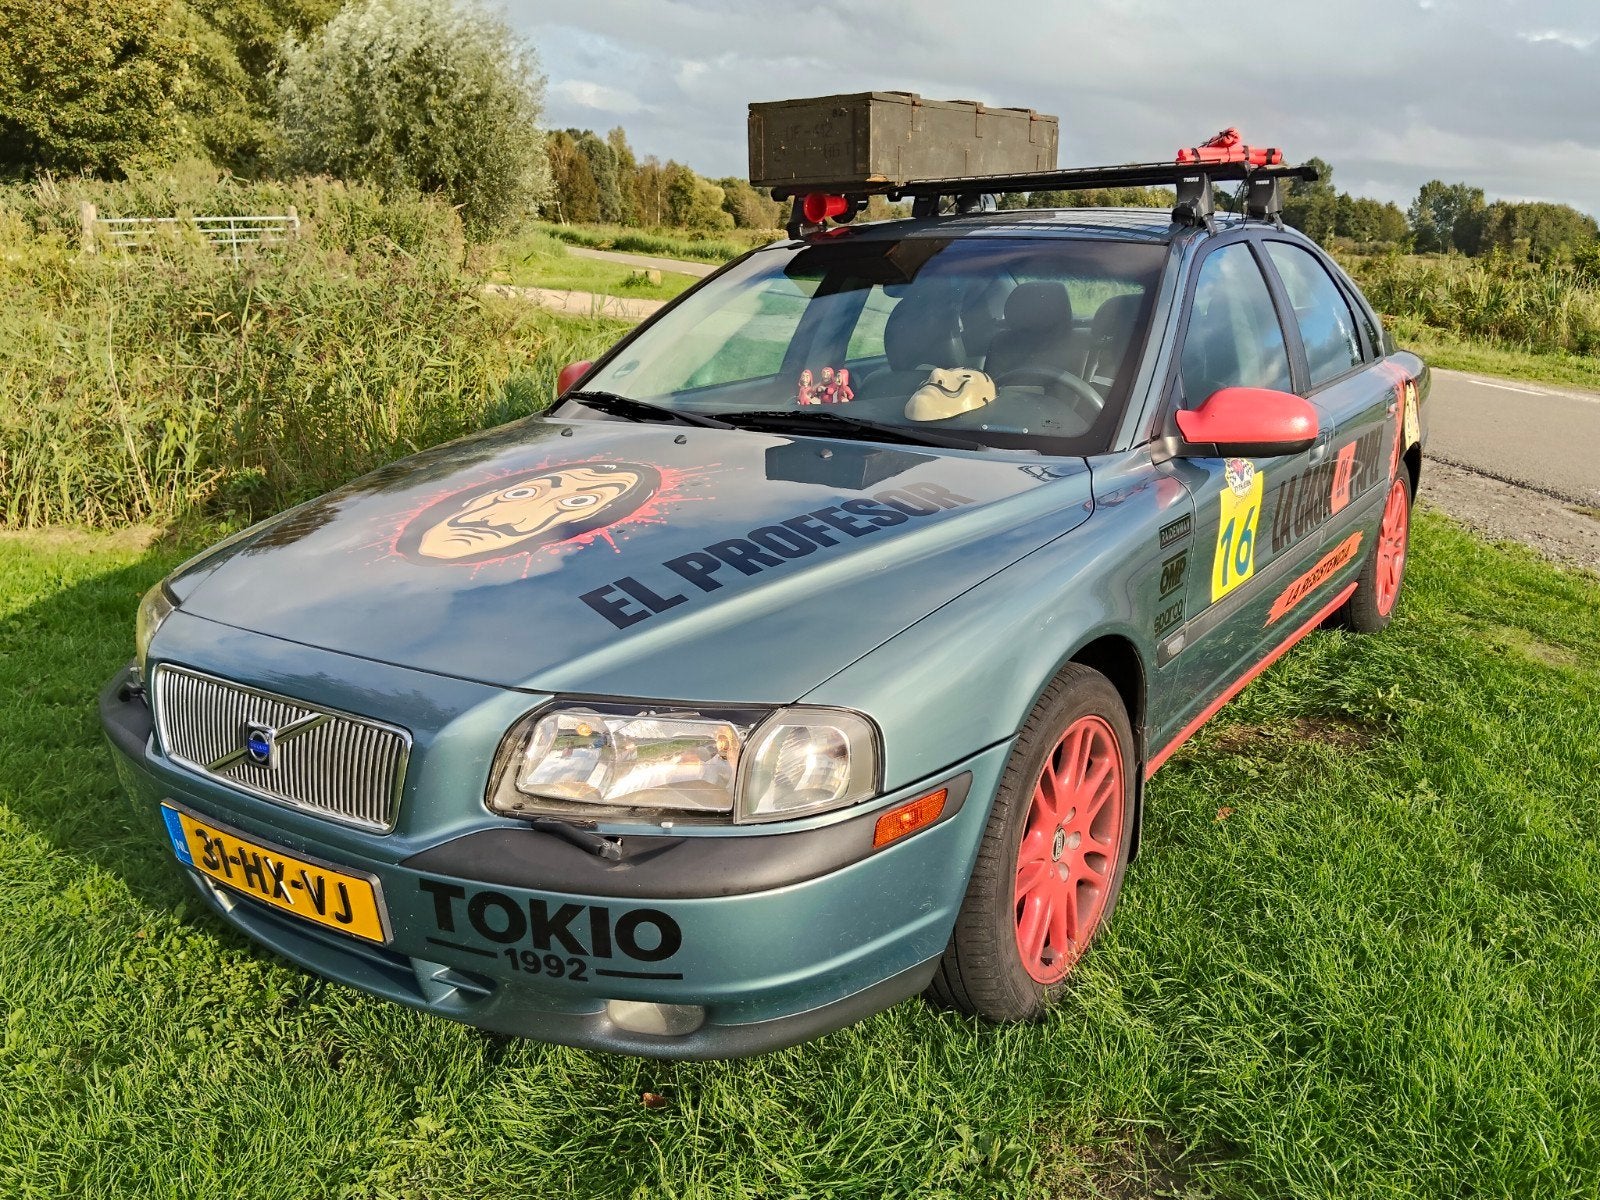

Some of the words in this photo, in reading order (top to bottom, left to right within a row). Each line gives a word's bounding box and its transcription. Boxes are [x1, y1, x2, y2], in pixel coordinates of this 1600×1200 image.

[577, 576, 690, 630] EL
[662, 482, 977, 593] PROFESOR
[1160, 556, 1187, 595] OMP
[1220, 505, 1255, 587] 16
[1154, 599, 1184, 637] sparco
[195, 828, 354, 925] 31-HX-VJ
[419, 877, 683, 962] TOKIO
[503, 947, 589, 982] 1992
